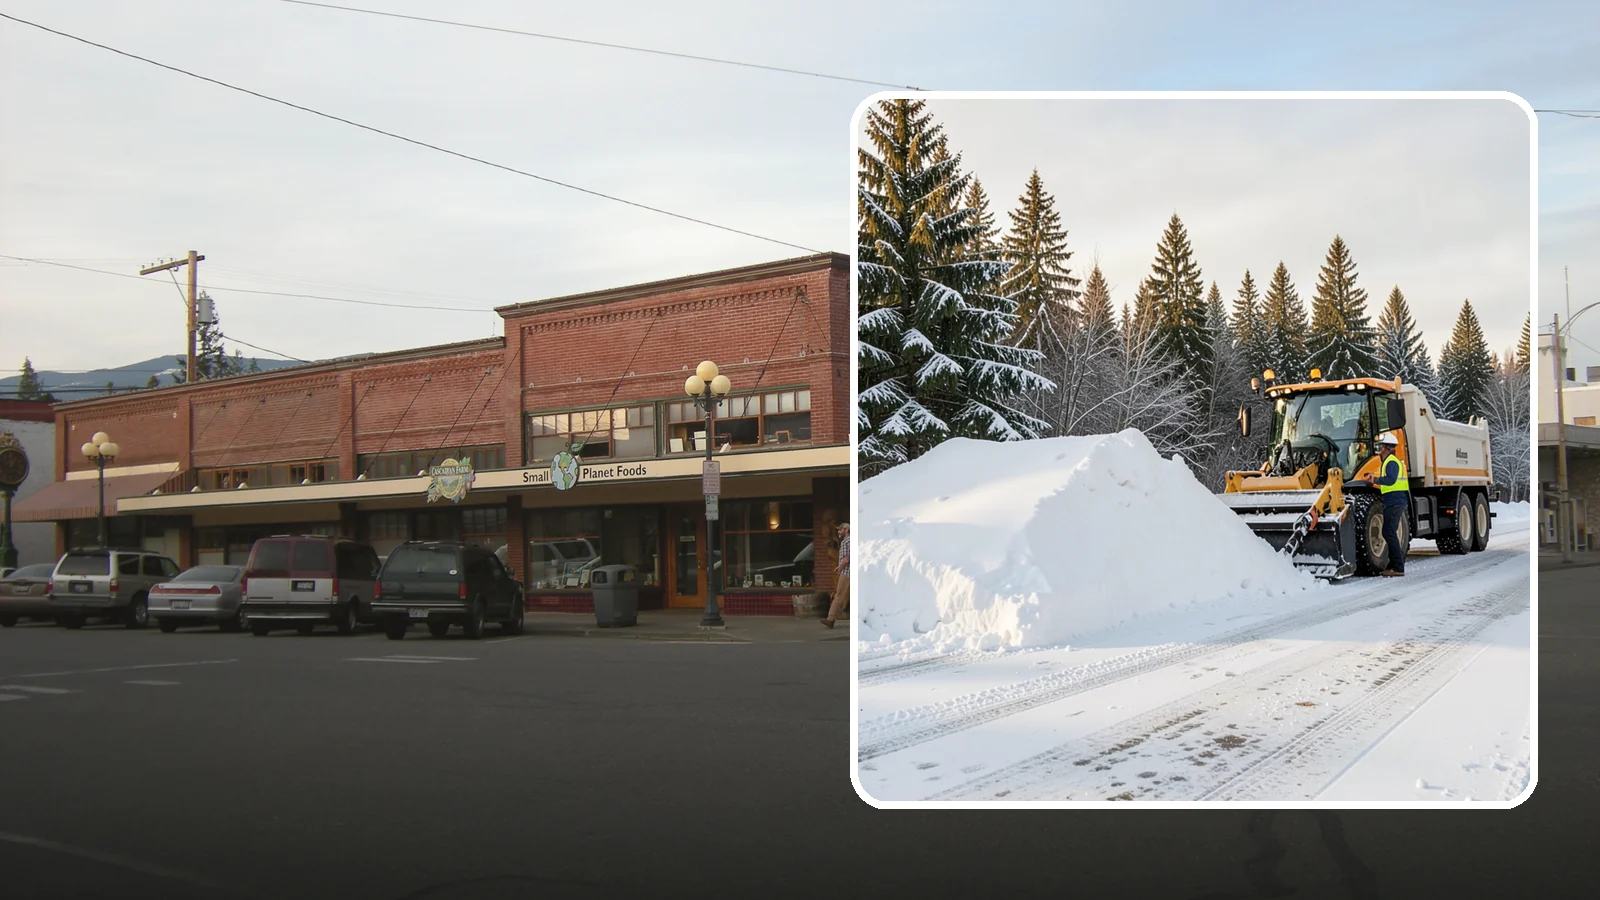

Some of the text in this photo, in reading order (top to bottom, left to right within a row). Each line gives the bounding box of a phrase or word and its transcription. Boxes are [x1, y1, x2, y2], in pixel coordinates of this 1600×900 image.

[523, 464, 647, 482] Small Planet Foods
